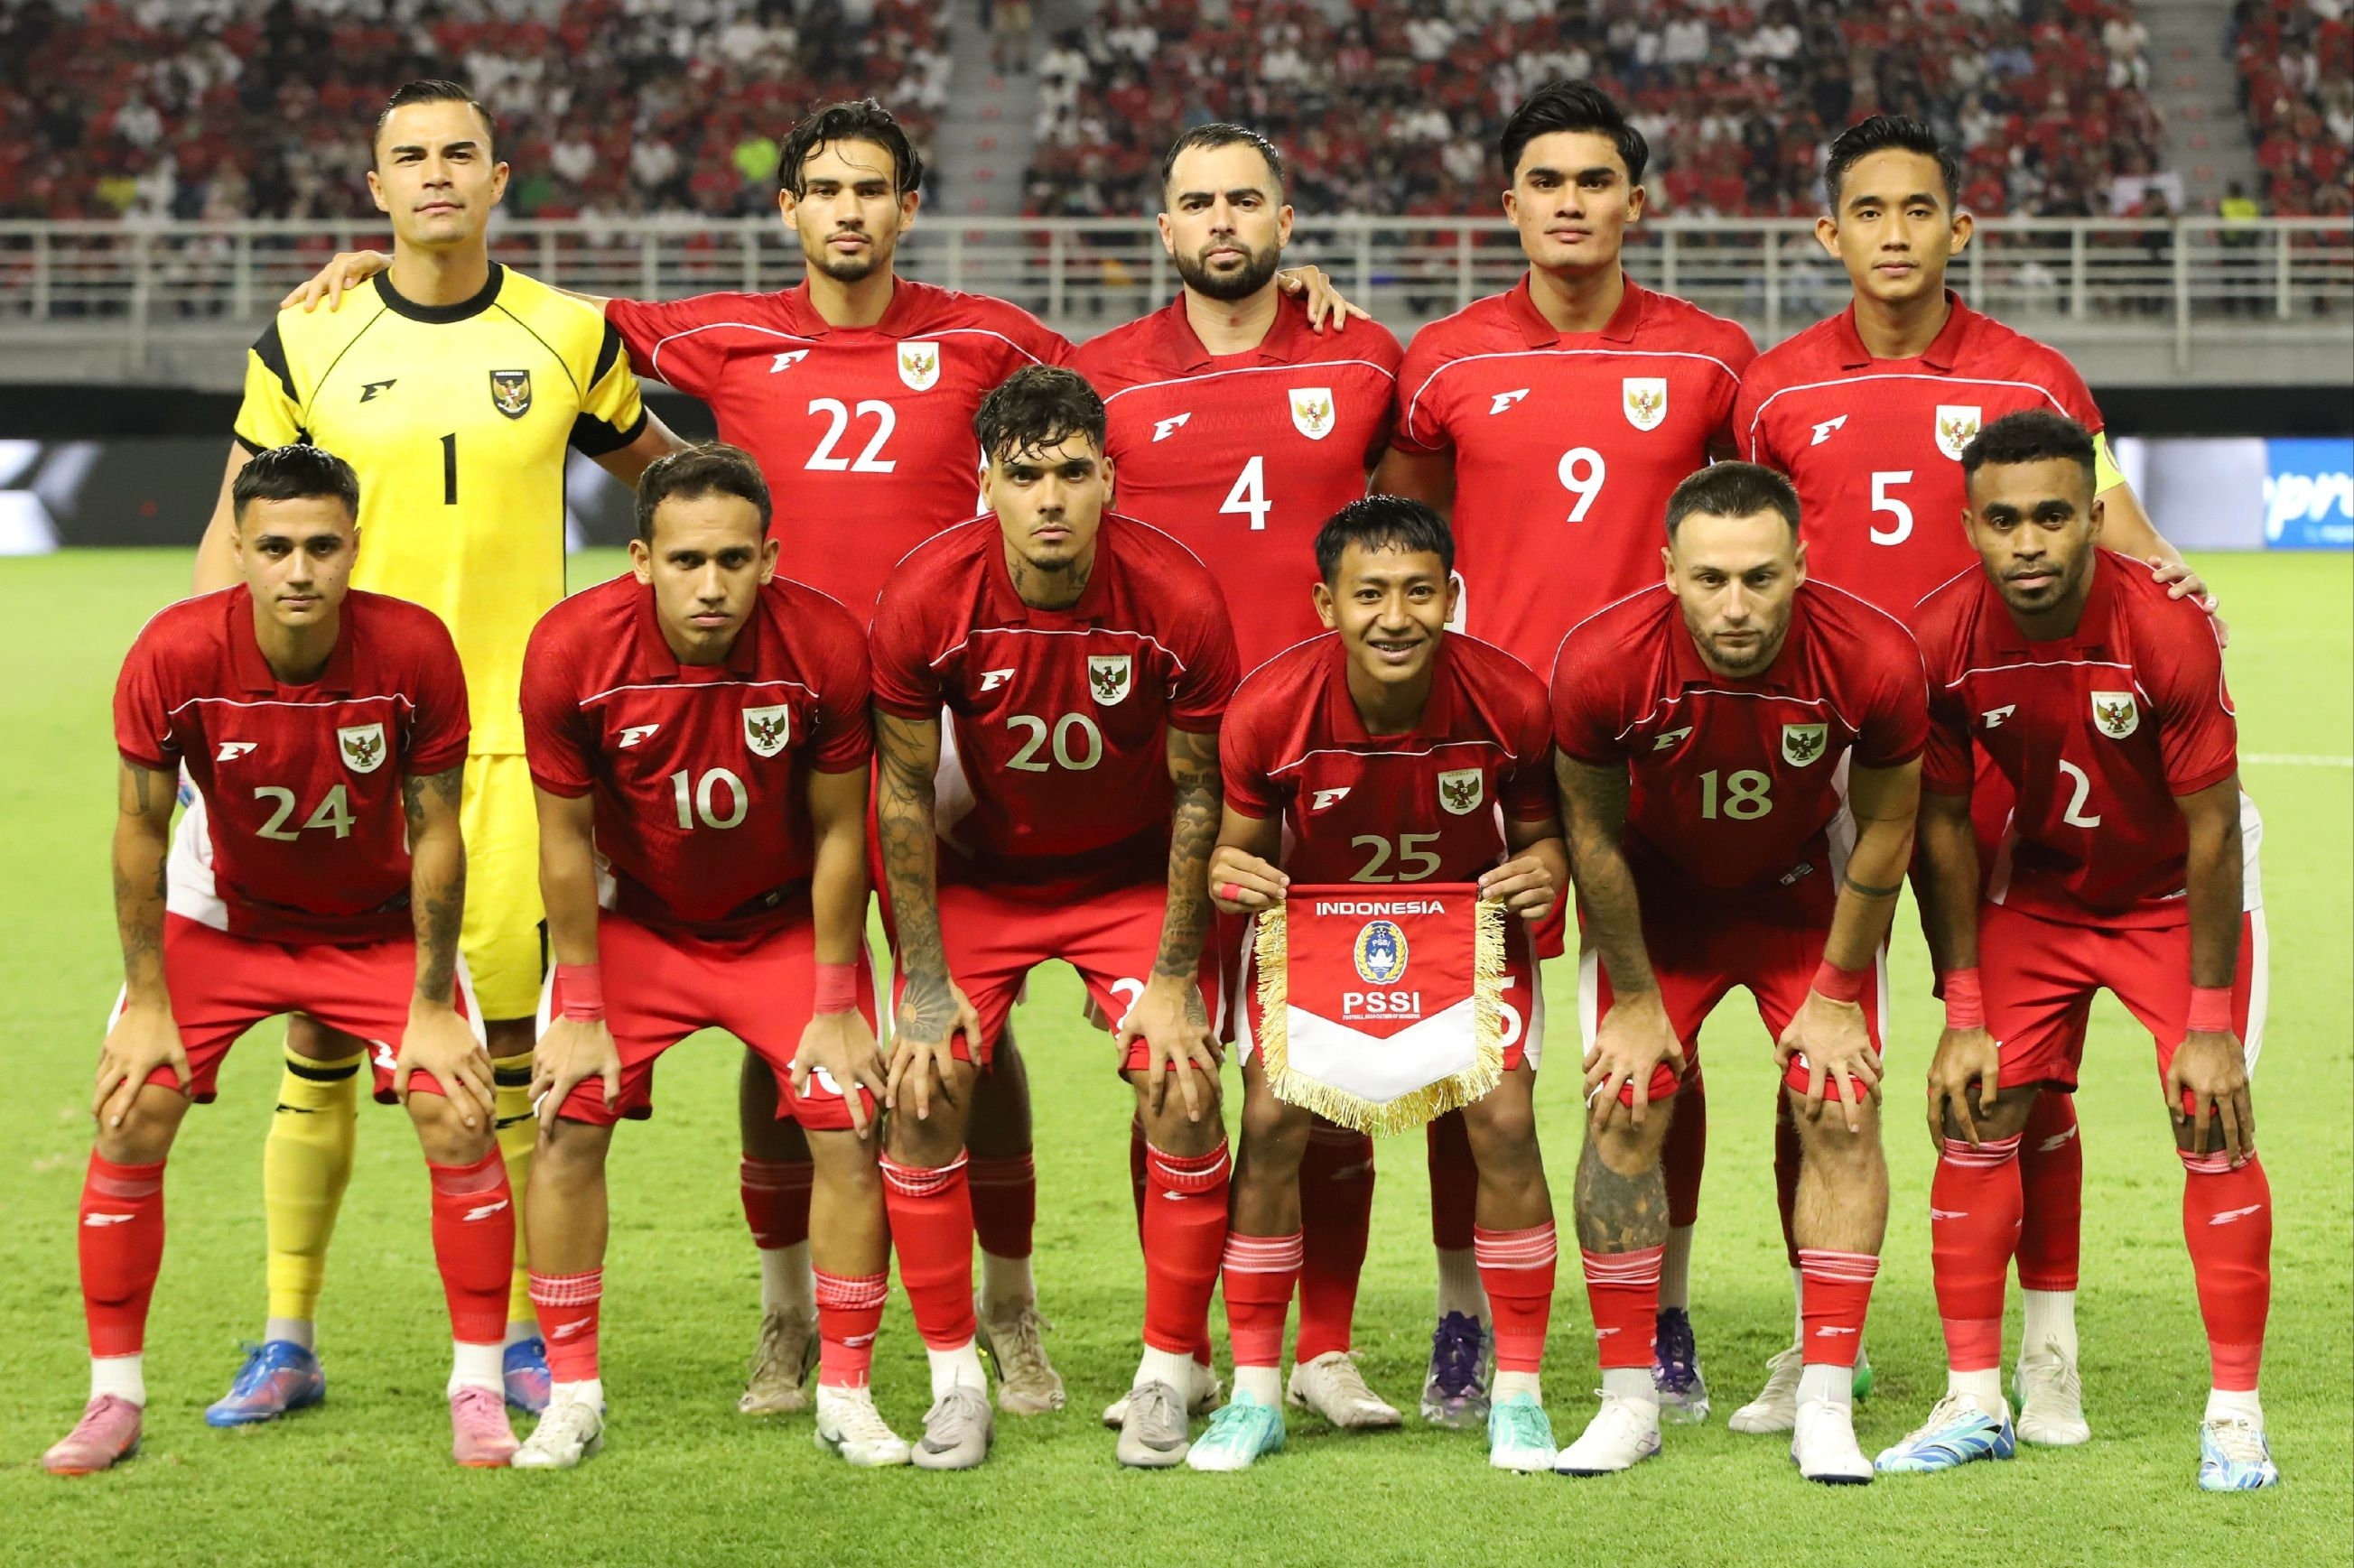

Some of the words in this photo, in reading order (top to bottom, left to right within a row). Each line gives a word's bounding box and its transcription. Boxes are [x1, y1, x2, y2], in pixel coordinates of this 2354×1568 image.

[804, 398, 897, 473] 22
[440, 433, 457, 505] 1
[1219, 456, 1273, 531] 4
[1558, 447, 1606, 523] 9
[1869, 470, 1914, 546] 5
[1005, 713, 1103, 772] 20
[254, 785, 356, 840] 24
[671, 768, 748, 829] 10
[1700, 770, 1772, 820] 18
[2060, 759, 2101, 828] 2
[1350, 831, 1442, 882] 25
[1316, 900, 1447, 916] INDONESIA
[1372, 939, 1391, 948] PSSI
[1343, 991, 1420, 1014] PSSI
